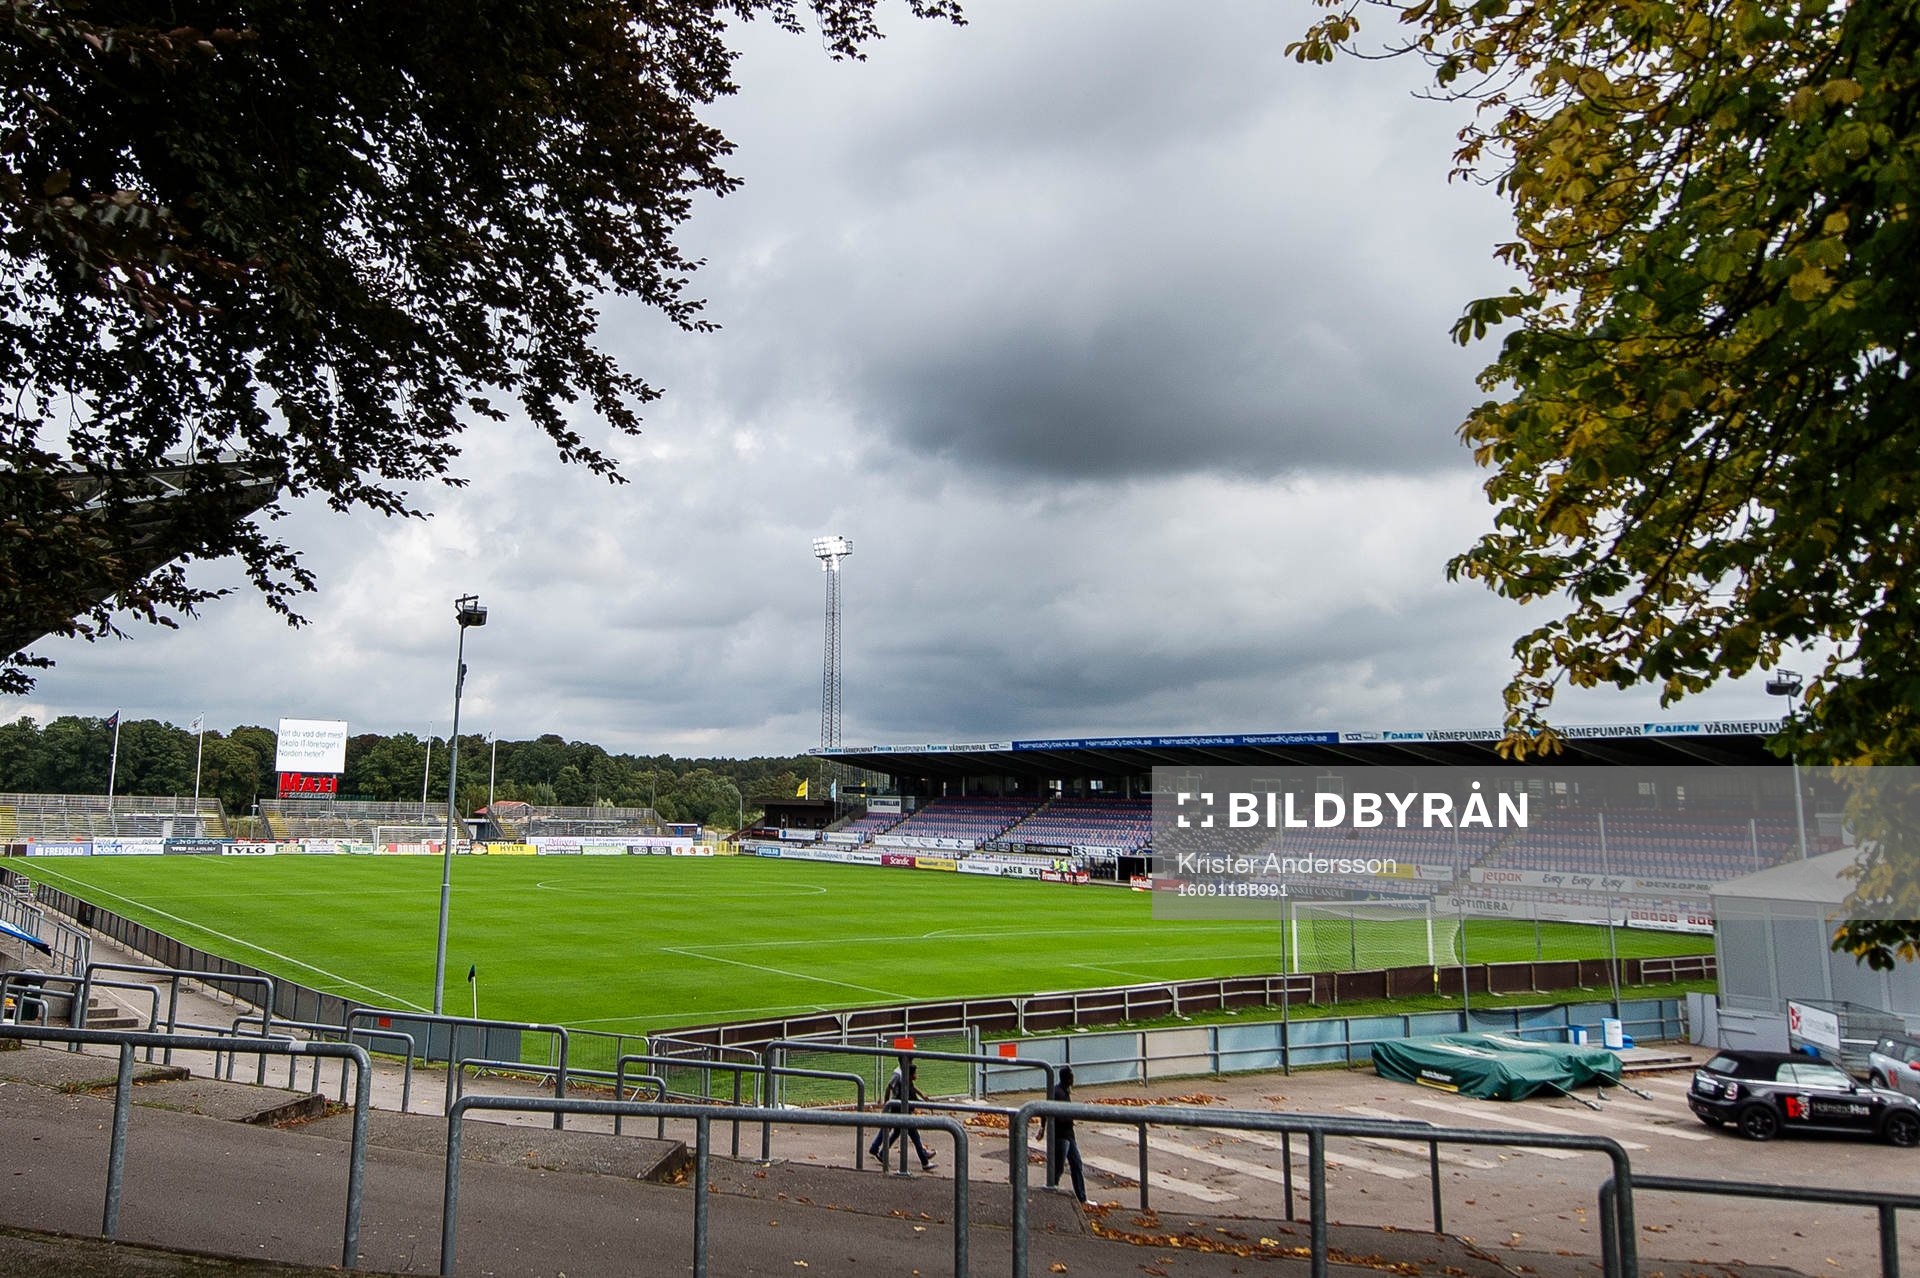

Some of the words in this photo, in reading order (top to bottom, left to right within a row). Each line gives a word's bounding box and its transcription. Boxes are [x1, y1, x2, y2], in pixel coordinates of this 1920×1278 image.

[1391, 732, 1424, 740] DAIKIN
[1426, 728, 1501, 741] VÄRMEPUMPAR
[1655, 723, 1700, 733] DAIKIN
[280, 772, 337, 793] MAXI
[889, 856, 910, 866] Scandic
[1008, 865, 1023, 874] SEB
[1481, 870, 1522, 883] jetpak
[1645, 880, 1696, 890] DUNLOP
[1451, 897, 1509, 912] OPTIMERA
